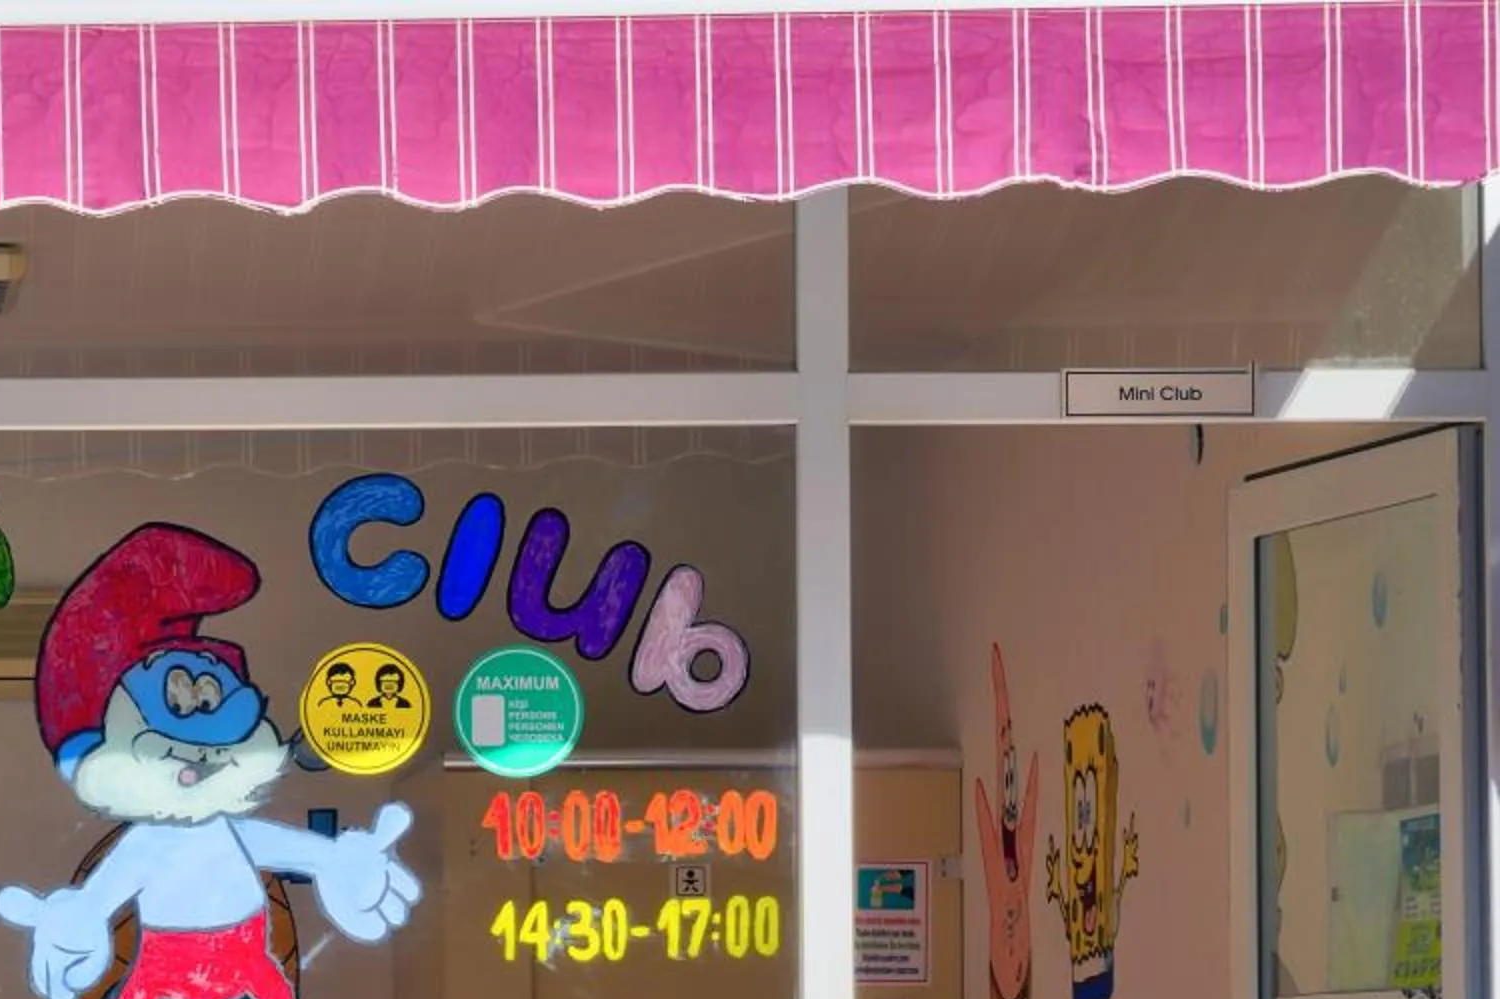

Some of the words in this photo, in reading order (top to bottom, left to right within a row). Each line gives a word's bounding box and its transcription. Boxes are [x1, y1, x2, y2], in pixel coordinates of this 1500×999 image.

[1119, 385, 1155, 401] Mini
[1159, 385, 1203, 401] Club
[476, 675, 560, 691] MAXIMUM
[341, 713, 388, 725] MASKE
[323, 726, 406, 739] KULLANMAYI
[481, 789, 778, 863] 10:00-12:00
[490, 896, 780, 962] 14:30-17:00
